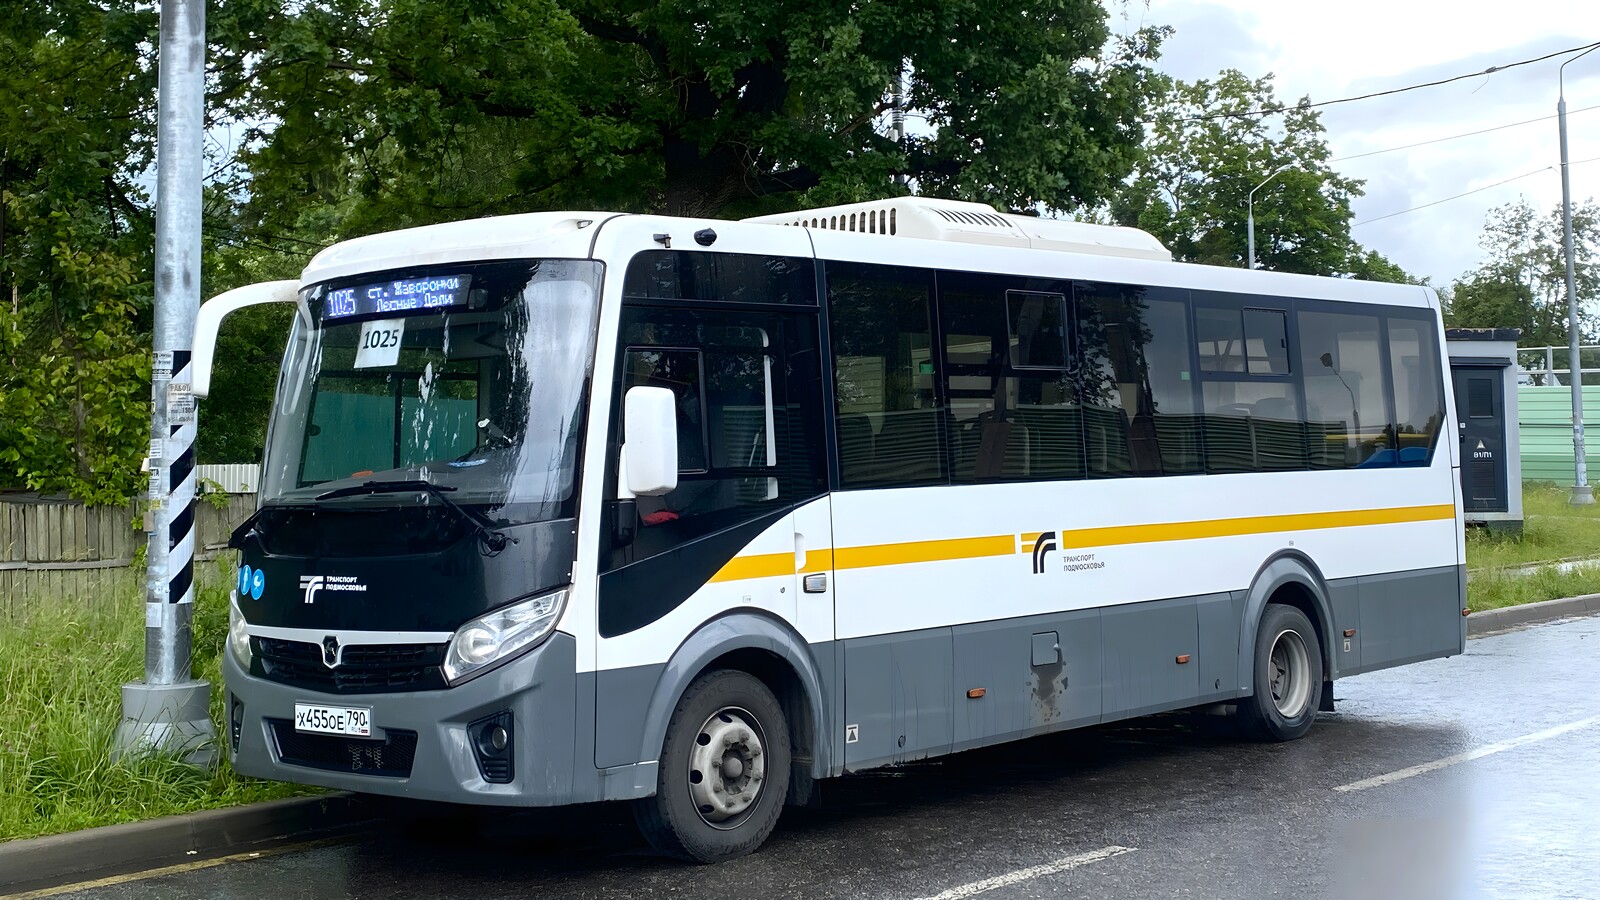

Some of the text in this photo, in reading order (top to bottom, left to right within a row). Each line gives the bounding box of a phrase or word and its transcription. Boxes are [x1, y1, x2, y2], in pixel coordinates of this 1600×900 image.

[394, 278, 459, 296] Жаворонки
[328, 290, 356, 316] 1025
[376, 293, 454, 313] Лесные Дали
[362, 329, 399, 349] 1025
[1063, 554, 1095, 563] ТРАНСПОРТ
[1063, 561, 1105, 572] ПОДМОСКОВЬЯ
[346, 710, 366, 727] 790
